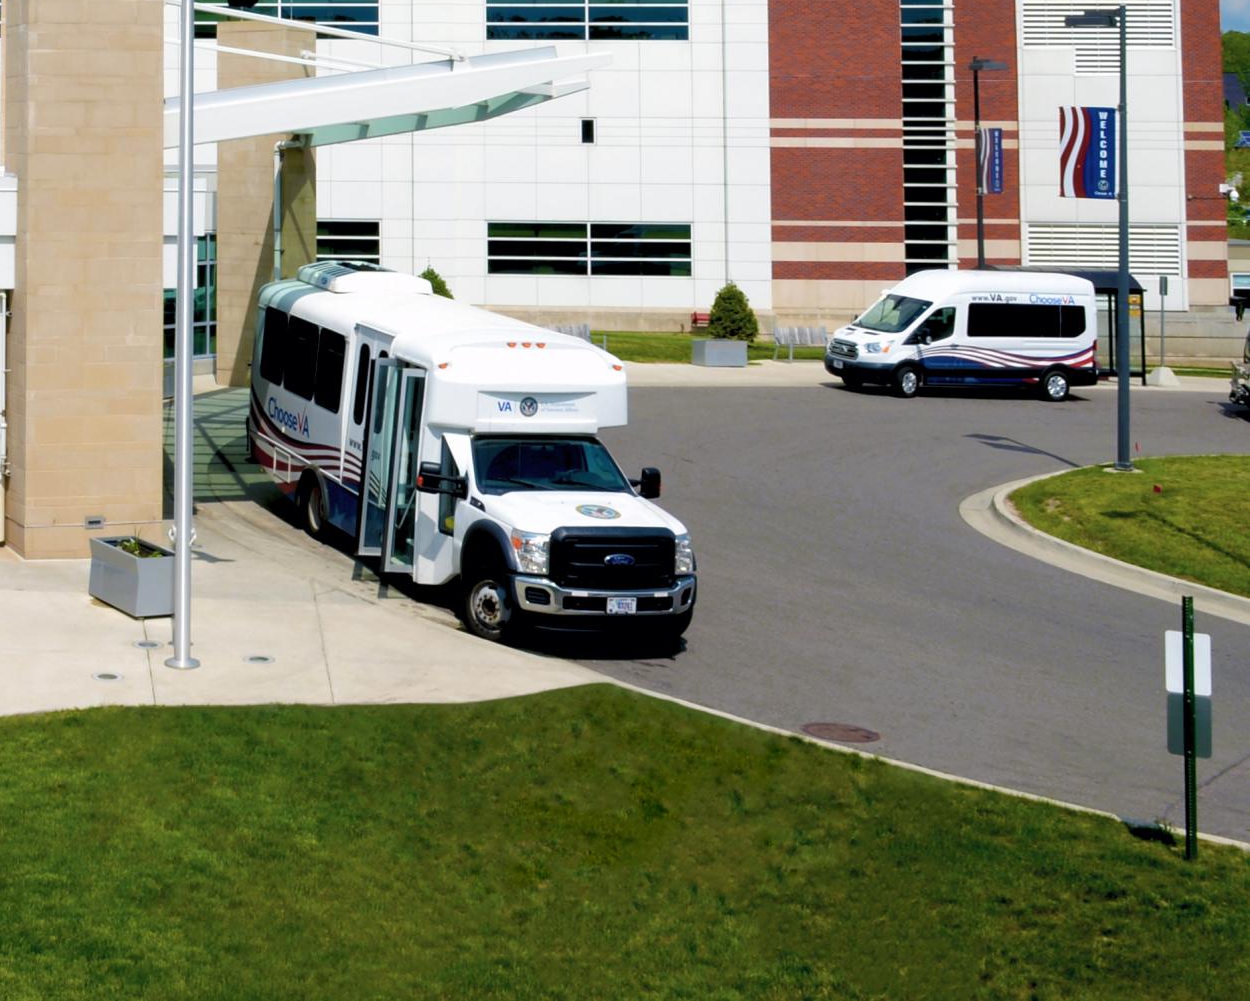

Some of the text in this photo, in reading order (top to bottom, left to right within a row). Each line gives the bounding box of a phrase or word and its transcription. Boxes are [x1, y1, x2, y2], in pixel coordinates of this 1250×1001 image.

[1098, 112, 1108, 178] WELCOME
[972, 294, 1017, 303] www.VA.gov
[498, 401, 512, 412] VA
